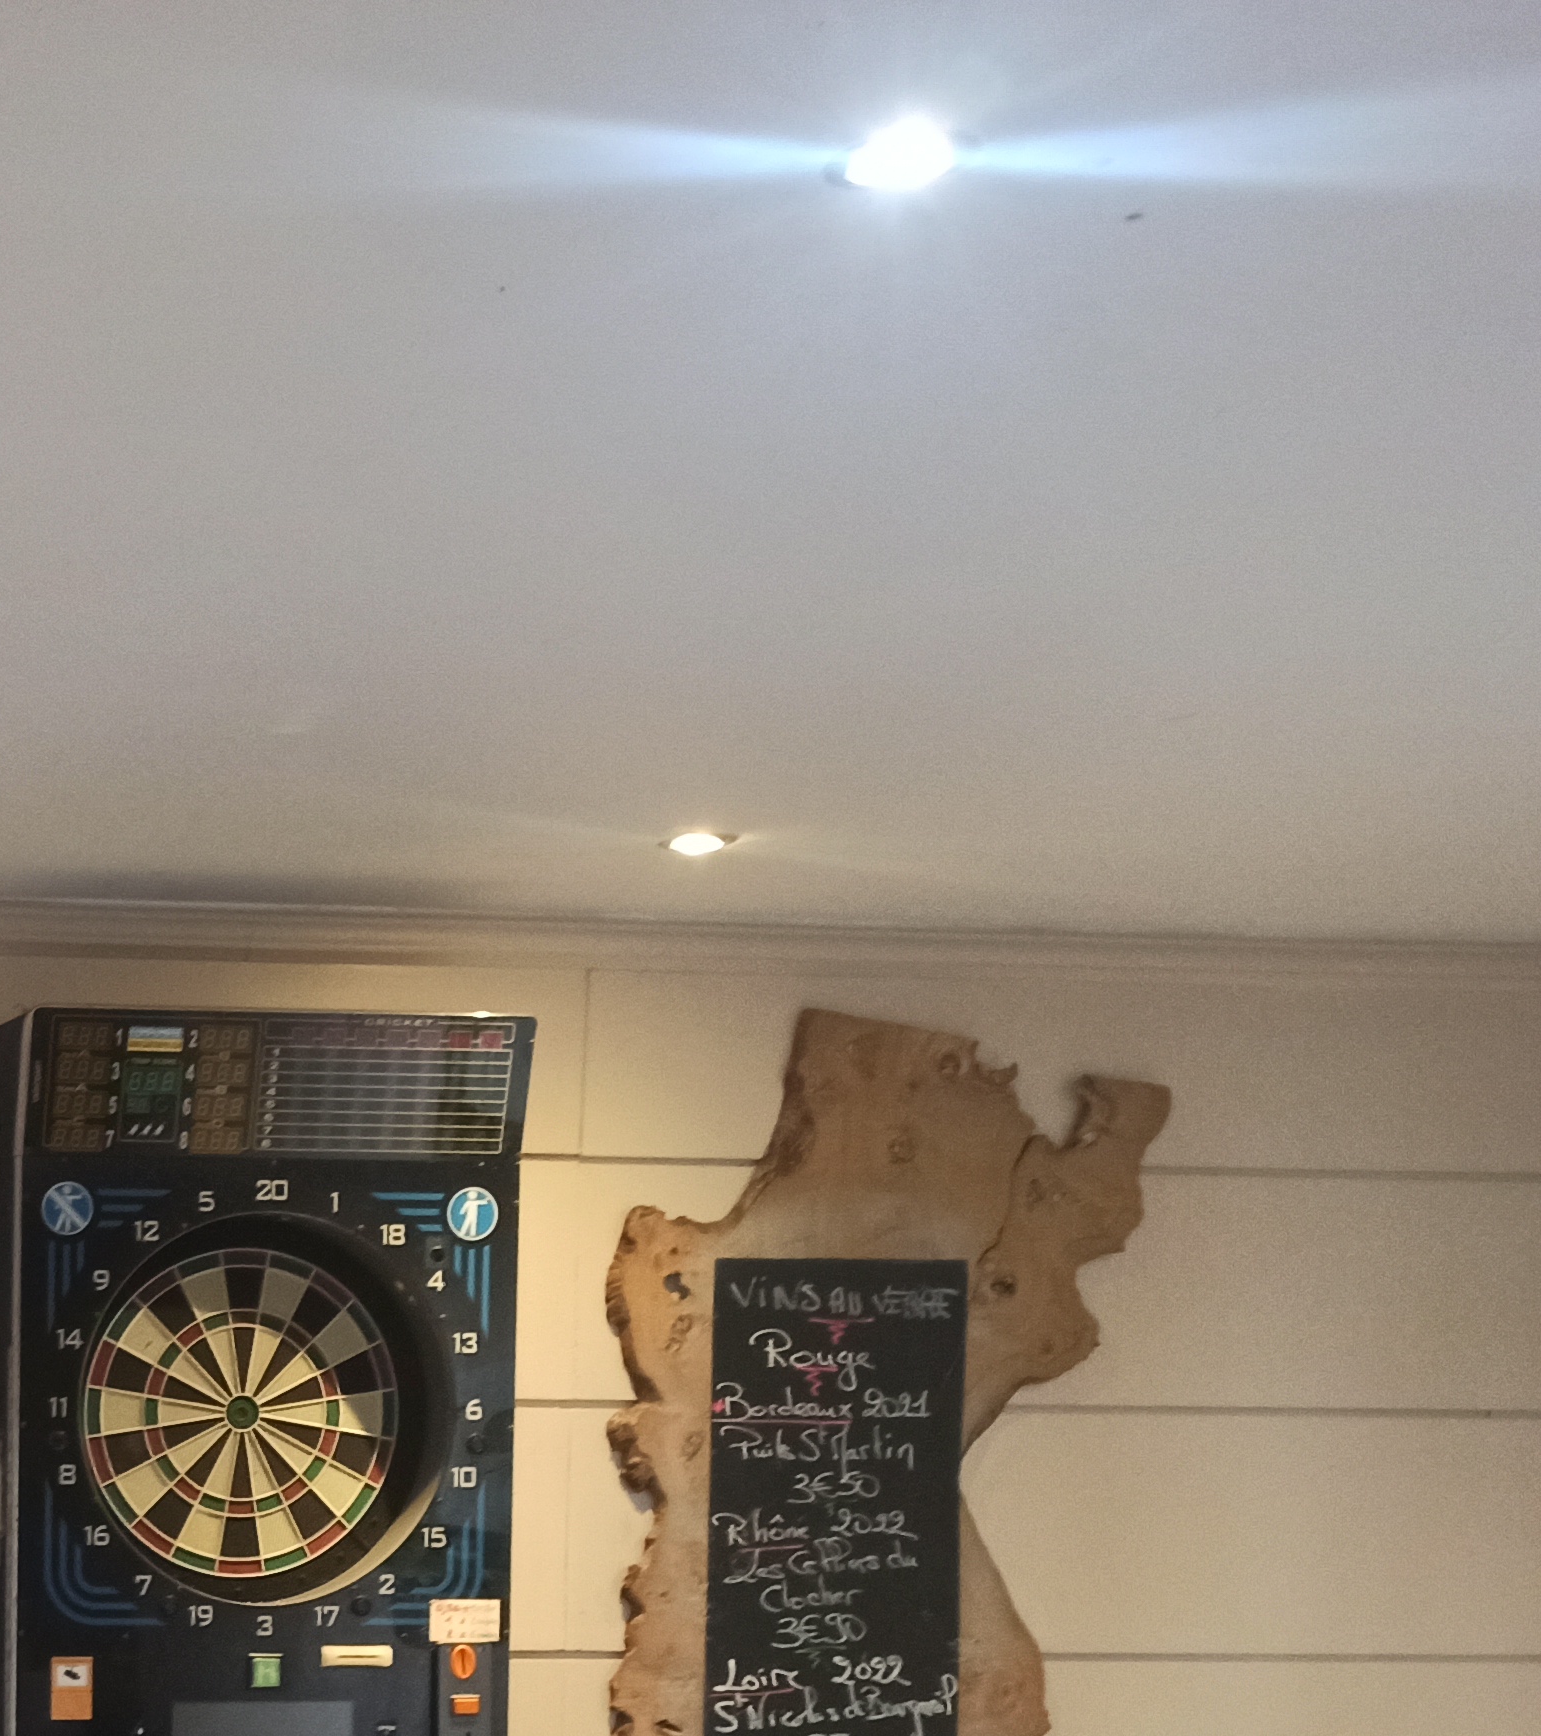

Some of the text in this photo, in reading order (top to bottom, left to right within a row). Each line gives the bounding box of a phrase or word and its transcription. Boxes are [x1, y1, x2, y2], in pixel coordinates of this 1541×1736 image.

[116, 1028, 123, 1046] 1
[189, 1028, 199, 1048] 2
[111, 1061, 120, 1081] 3
[184, 1064, 195, 1082] 4
[108, 1095, 118, 1115] 5
[105, 1130, 115, 1148] 7
[198, 1190, 215, 1212] 5
[255, 1179, 289, 1201] 20
[330, 1191, 339, 1213] 1
[134, 1220, 160, 1242] 12
[379, 1223, 406, 1246] 18
[93, 1269, 110, 1291] 9
[426, 1269, 445, 1292] 4
[57, 1328, 84, 1350] 14
[452, 1332, 478, 1354] 13
[748, 1327, 876, 1392] Rouge
[49, 1396, 68, 1418] 11
[465, 1398, 483, 1421] 6
[716, 1381, 932, 1420] Bordeaux 2021
[59, 1463, 77, 1485] 8
[450, 1466, 477, 1488] 10
[84, 1524, 110, 1546] 16
[421, 1526, 447, 1548] 15
[711, 1508, 811, 1546] Rhône
[134, 1574, 153, 1596] 7
[378, 1573, 396, 1595] 2
[188, 1605, 214, 1627] 19
[256, 1615, 273, 1636] 3
[314, 1605, 340, 1627] 17
[713, 1658, 805, 1691] Loire
